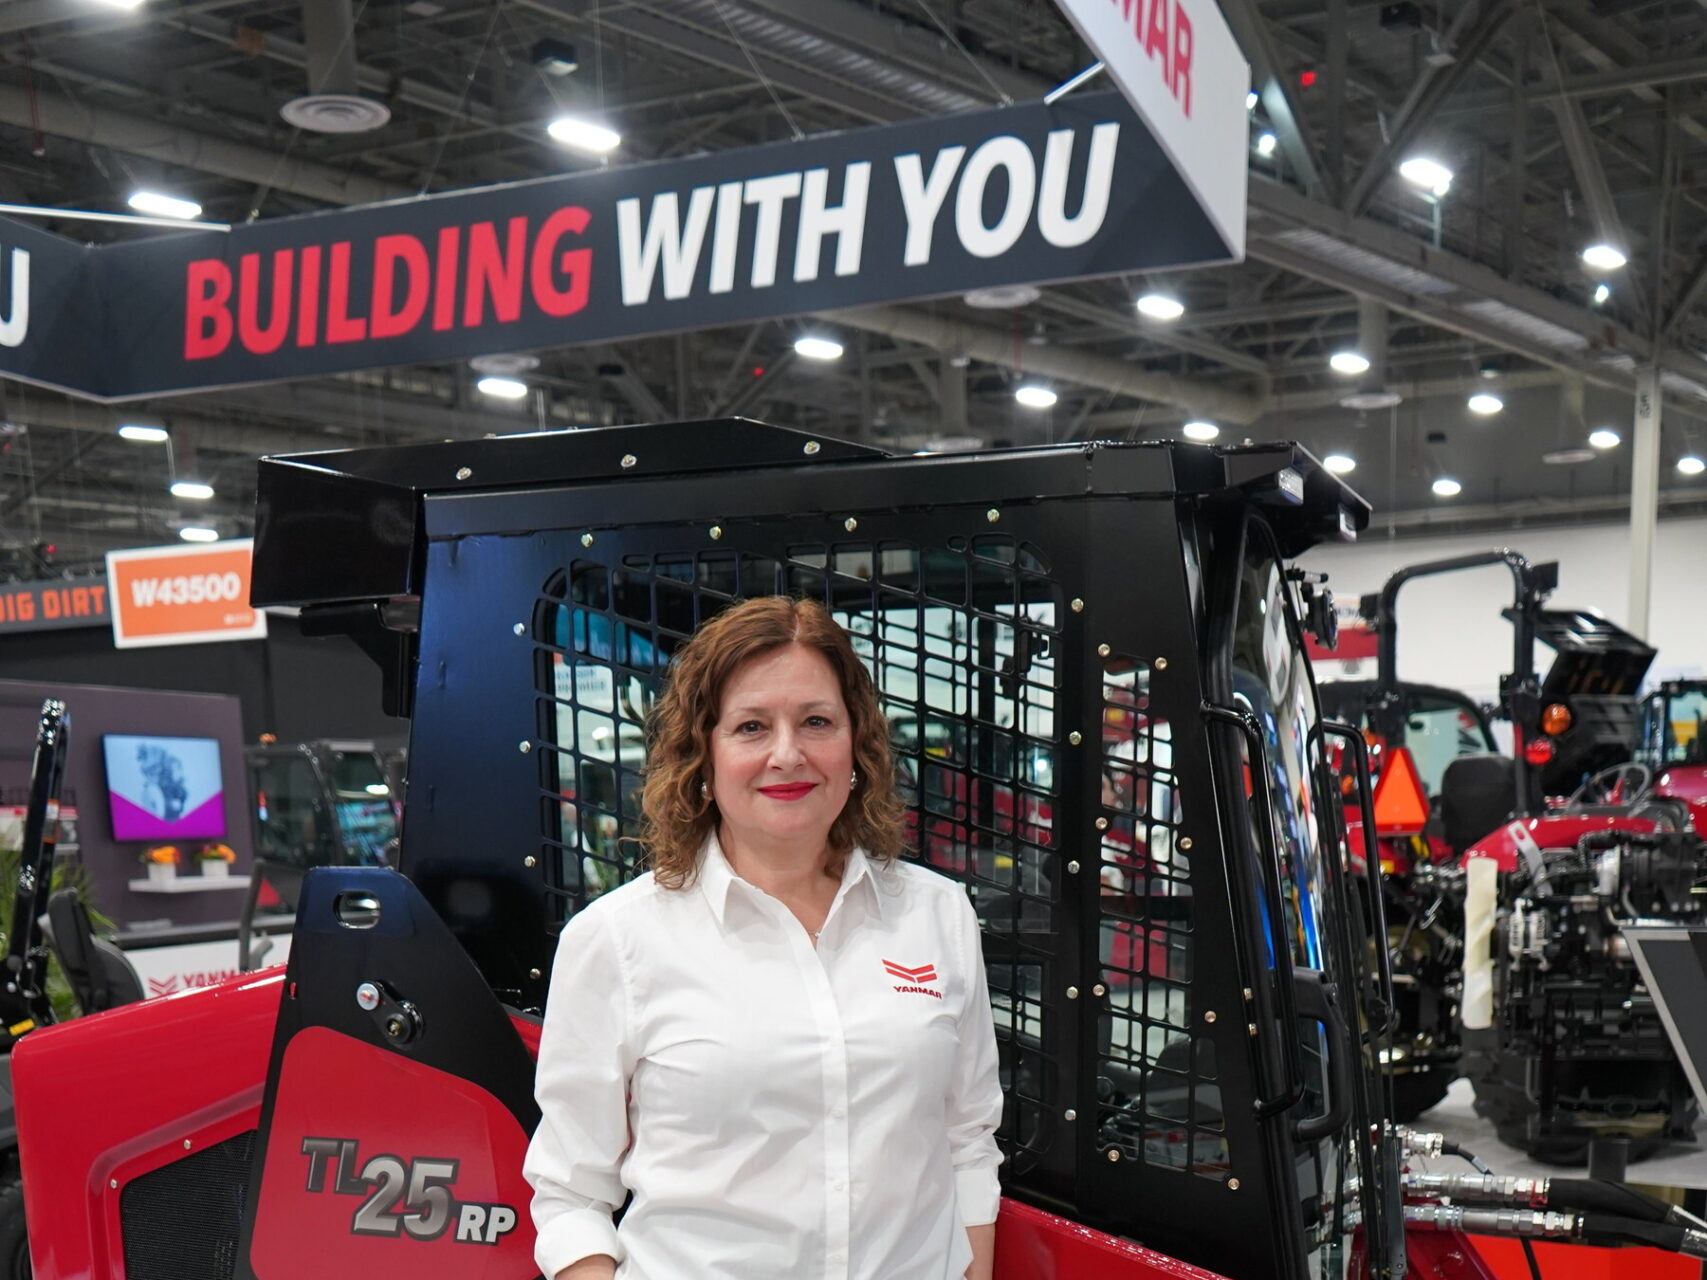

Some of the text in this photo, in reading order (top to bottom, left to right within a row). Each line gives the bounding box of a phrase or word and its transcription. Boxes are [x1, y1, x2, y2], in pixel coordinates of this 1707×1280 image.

[184, 122, 1120, 360] BUILDING WITH YOU
[42, 585, 106, 619] DIRT
[132, 572, 240, 607] W43500
[893, 985, 943, 1000] YANMAR
